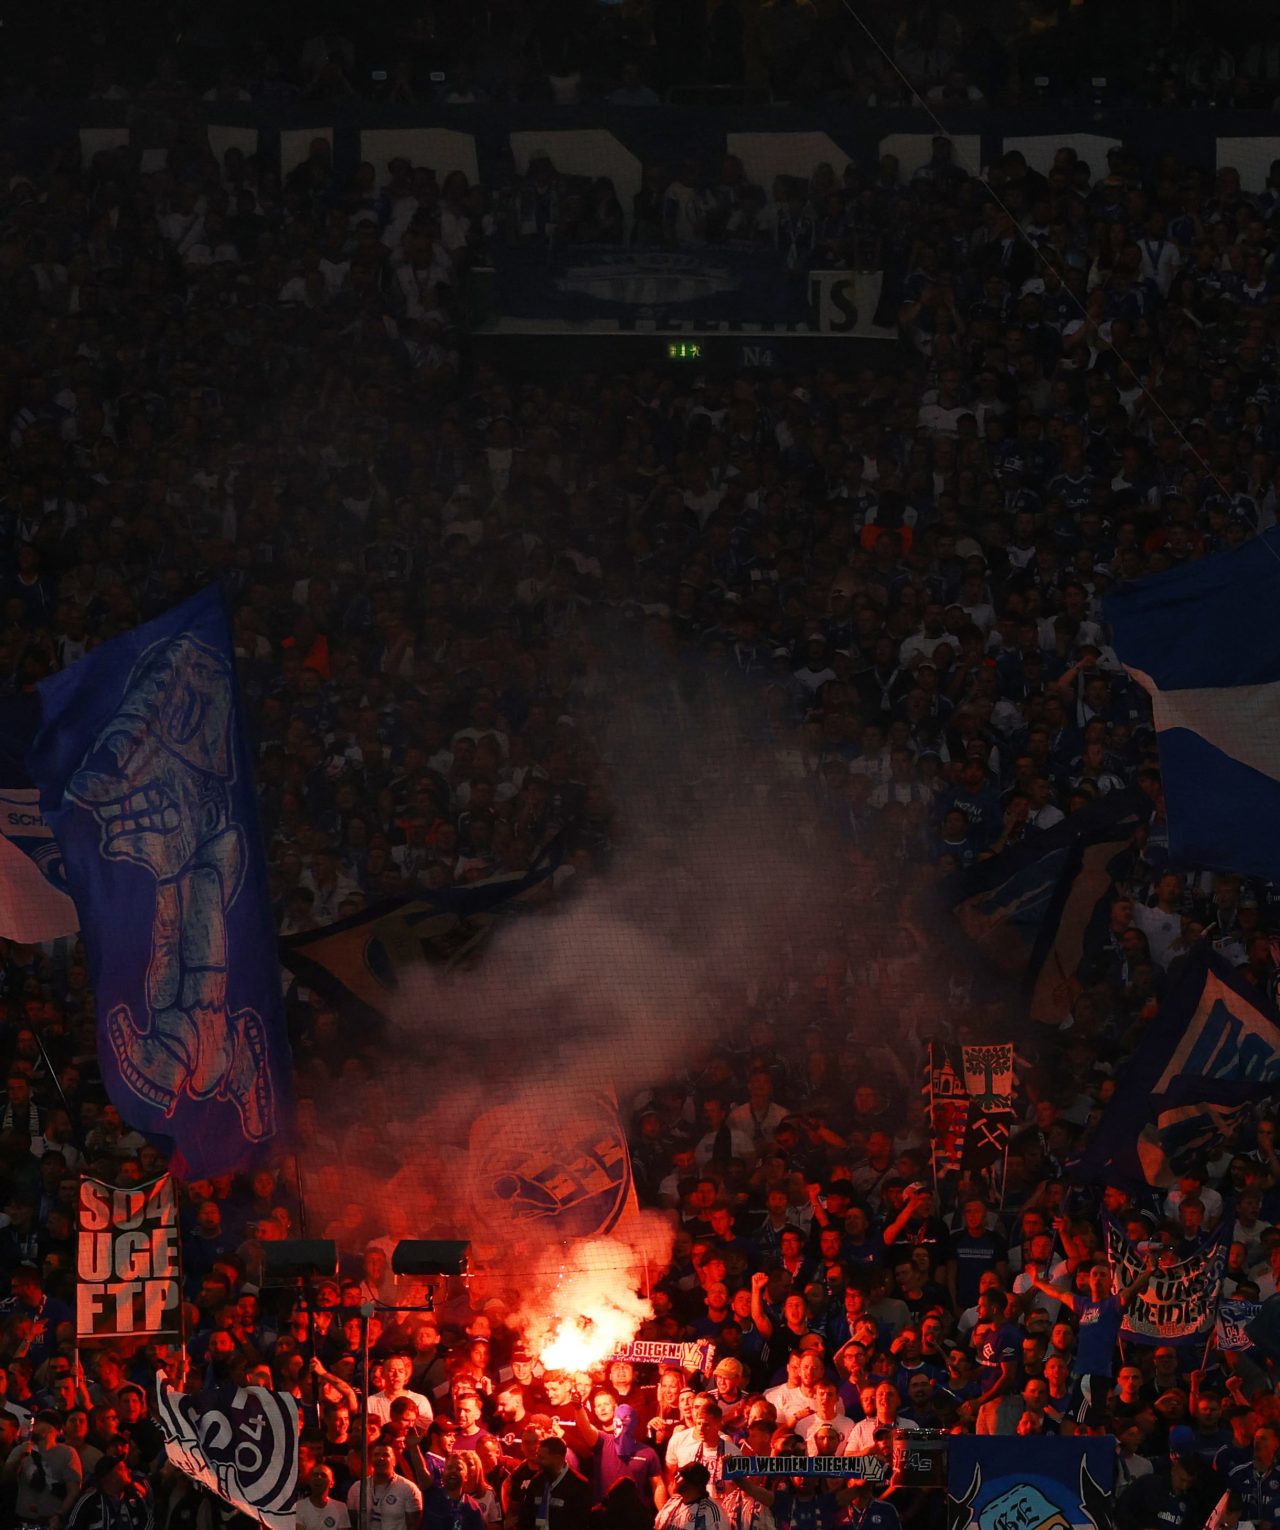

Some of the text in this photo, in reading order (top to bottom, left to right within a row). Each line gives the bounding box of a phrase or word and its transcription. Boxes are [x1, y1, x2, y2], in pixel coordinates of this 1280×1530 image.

[8, 811, 48, 827] SCH
[78, 1227, 179, 1283] UGE
[76, 1279, 180, 1334] FTP
[726, 1456, 861, 1473] WIR WERDEN SIEGEN!
